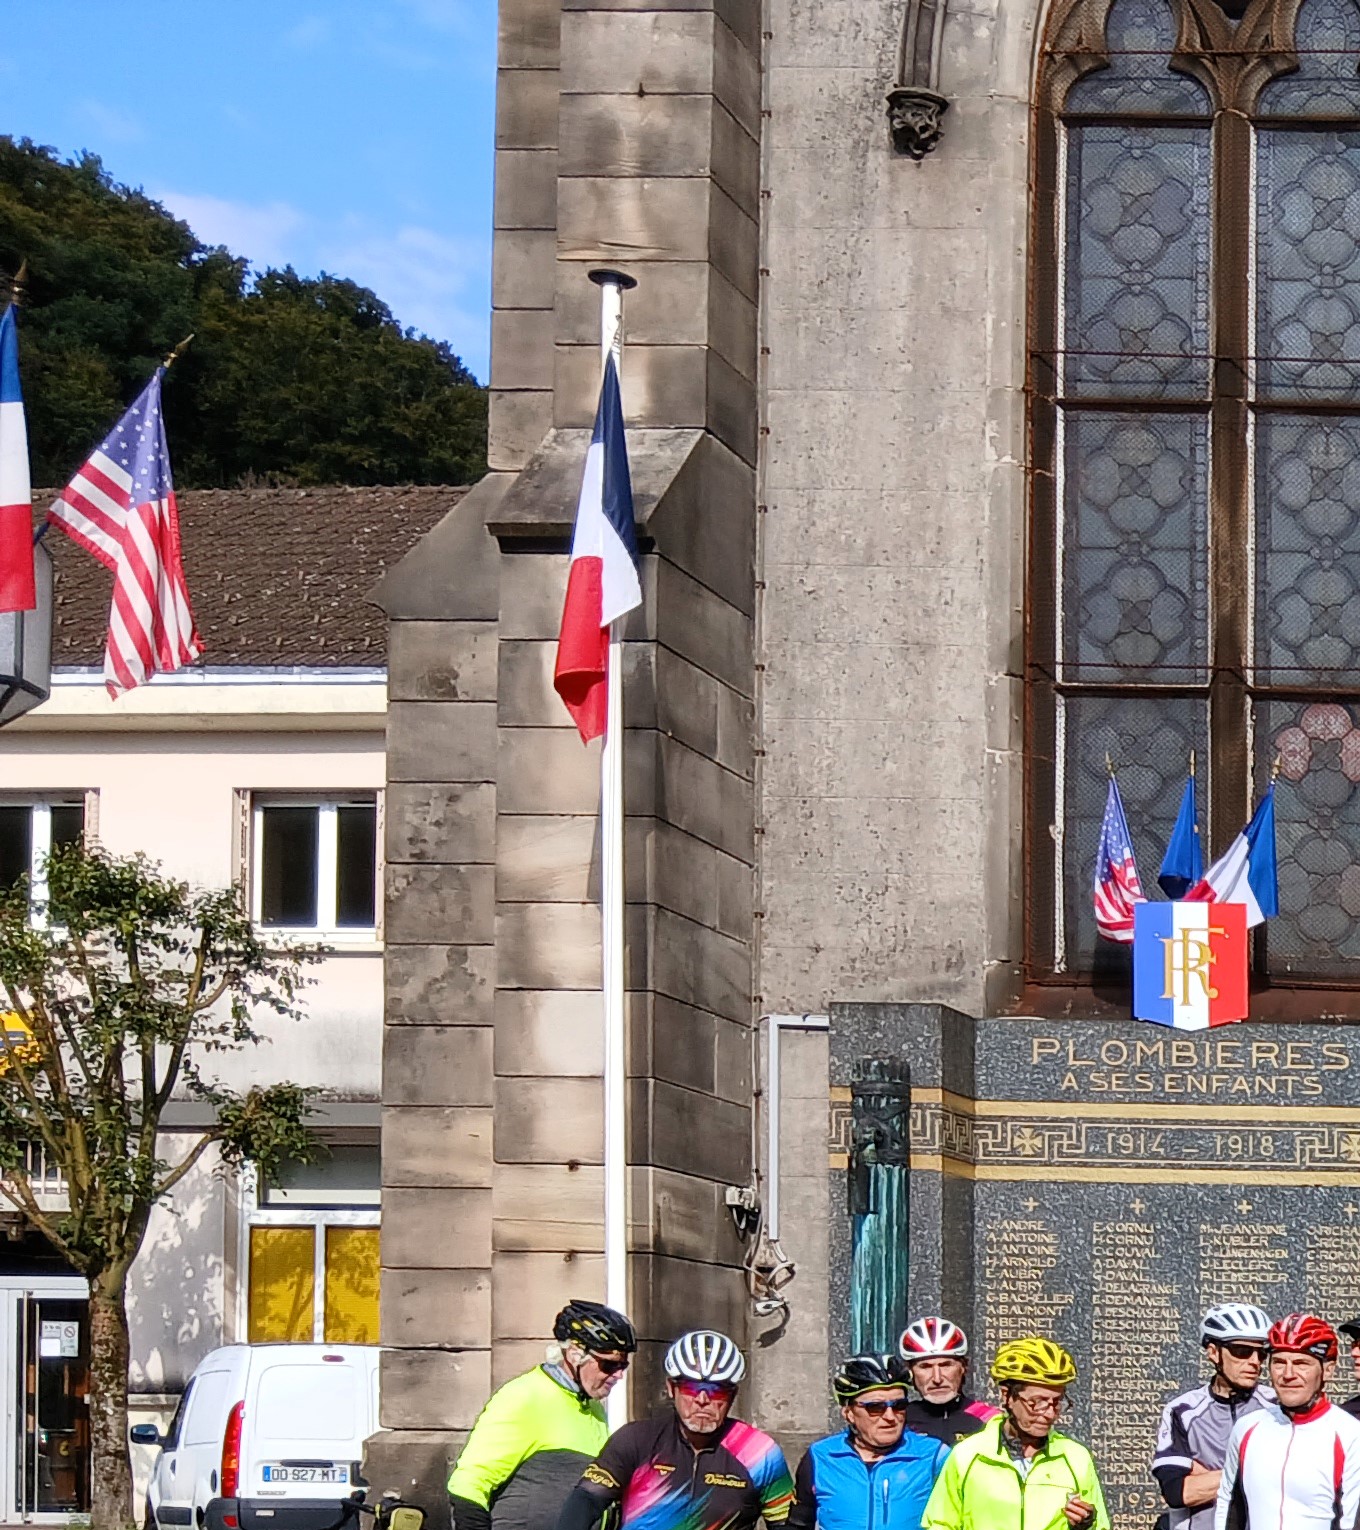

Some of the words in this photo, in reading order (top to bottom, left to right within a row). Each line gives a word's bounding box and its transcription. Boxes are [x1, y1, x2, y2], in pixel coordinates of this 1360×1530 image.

[1031, 1037, 1350, 1070] PLOMBIERES
[1061, 1072, 1079, 1091] A
[1089, 1073, 1154, 1092] SES
[1164, 1074, 1323, 1095] ENFANTS
[1107, 1133, 1165, 1154] 1914
[1215, 1134, 1275, 1156] 1918
